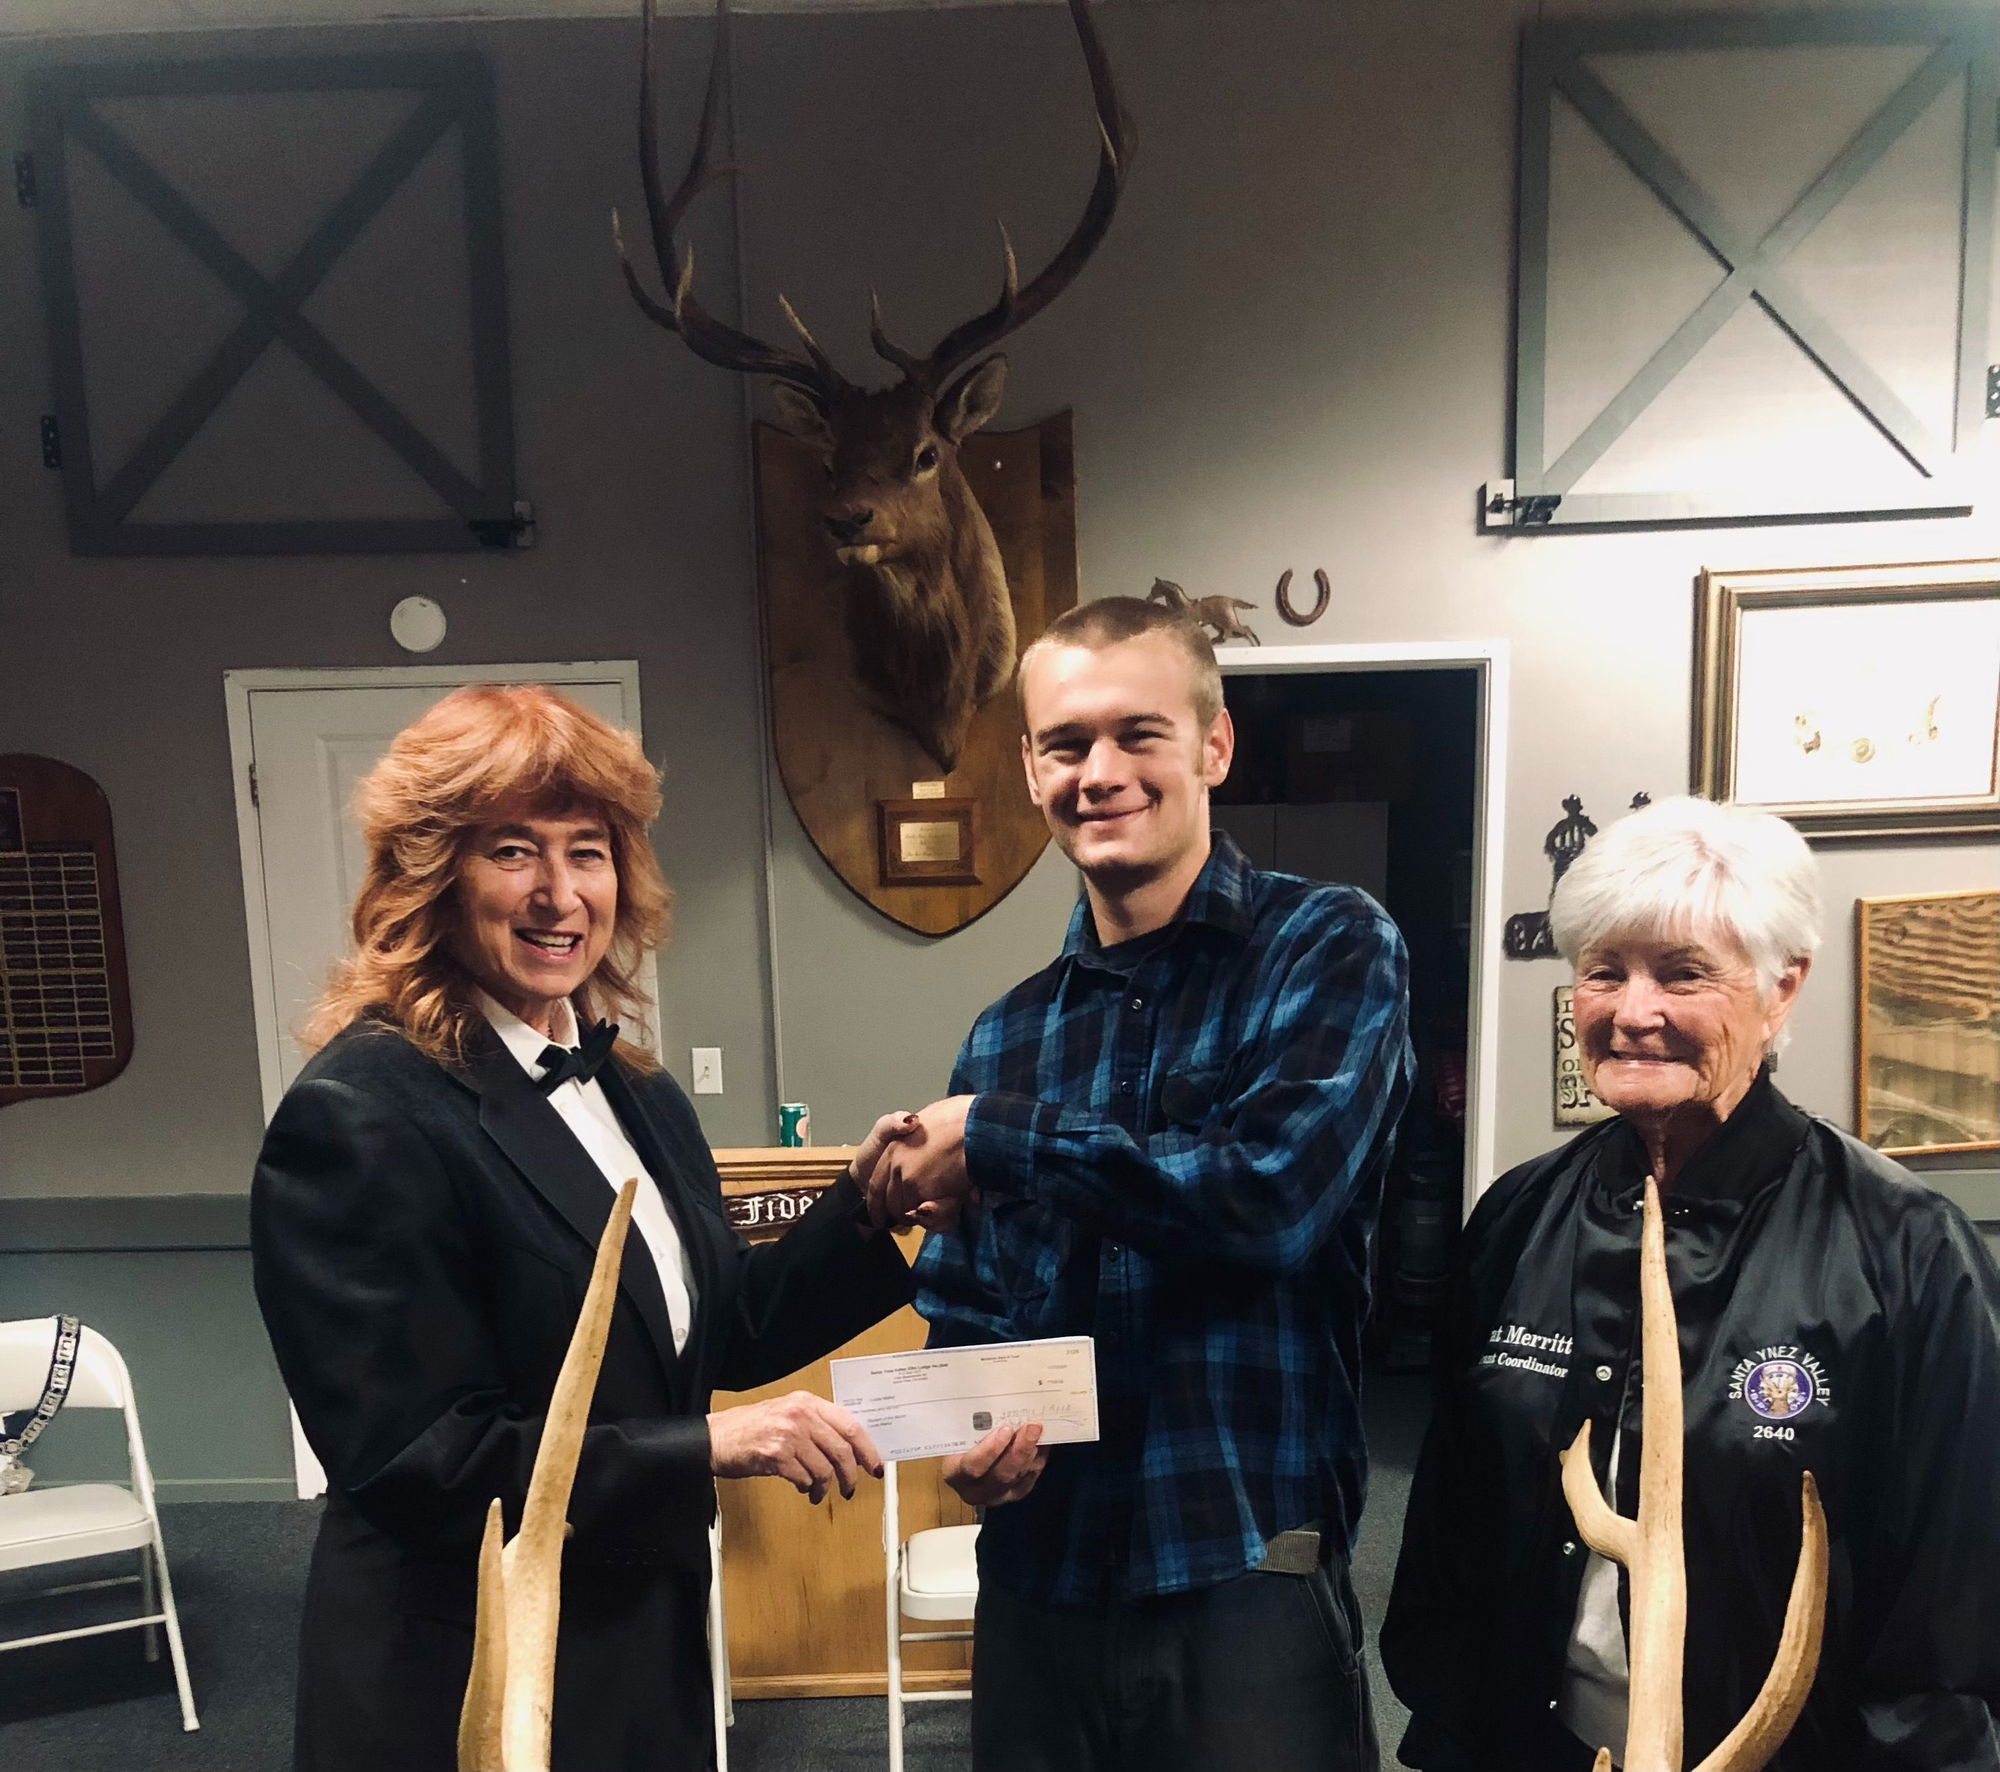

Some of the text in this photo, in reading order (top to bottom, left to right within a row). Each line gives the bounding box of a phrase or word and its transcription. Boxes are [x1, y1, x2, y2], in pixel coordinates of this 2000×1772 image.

[1503, 1325, 1574, 1355] Merritt
[1497, 1352, 1569, 1378] Coordinator
[1728, 1358, 1757, 1400] SANTA
[1756, 1346, 1799, 1361] YNEZ
[1801, 1352, 1831, 1407] VALLEY
[1753, 1425, 1796, 1441] 2640
